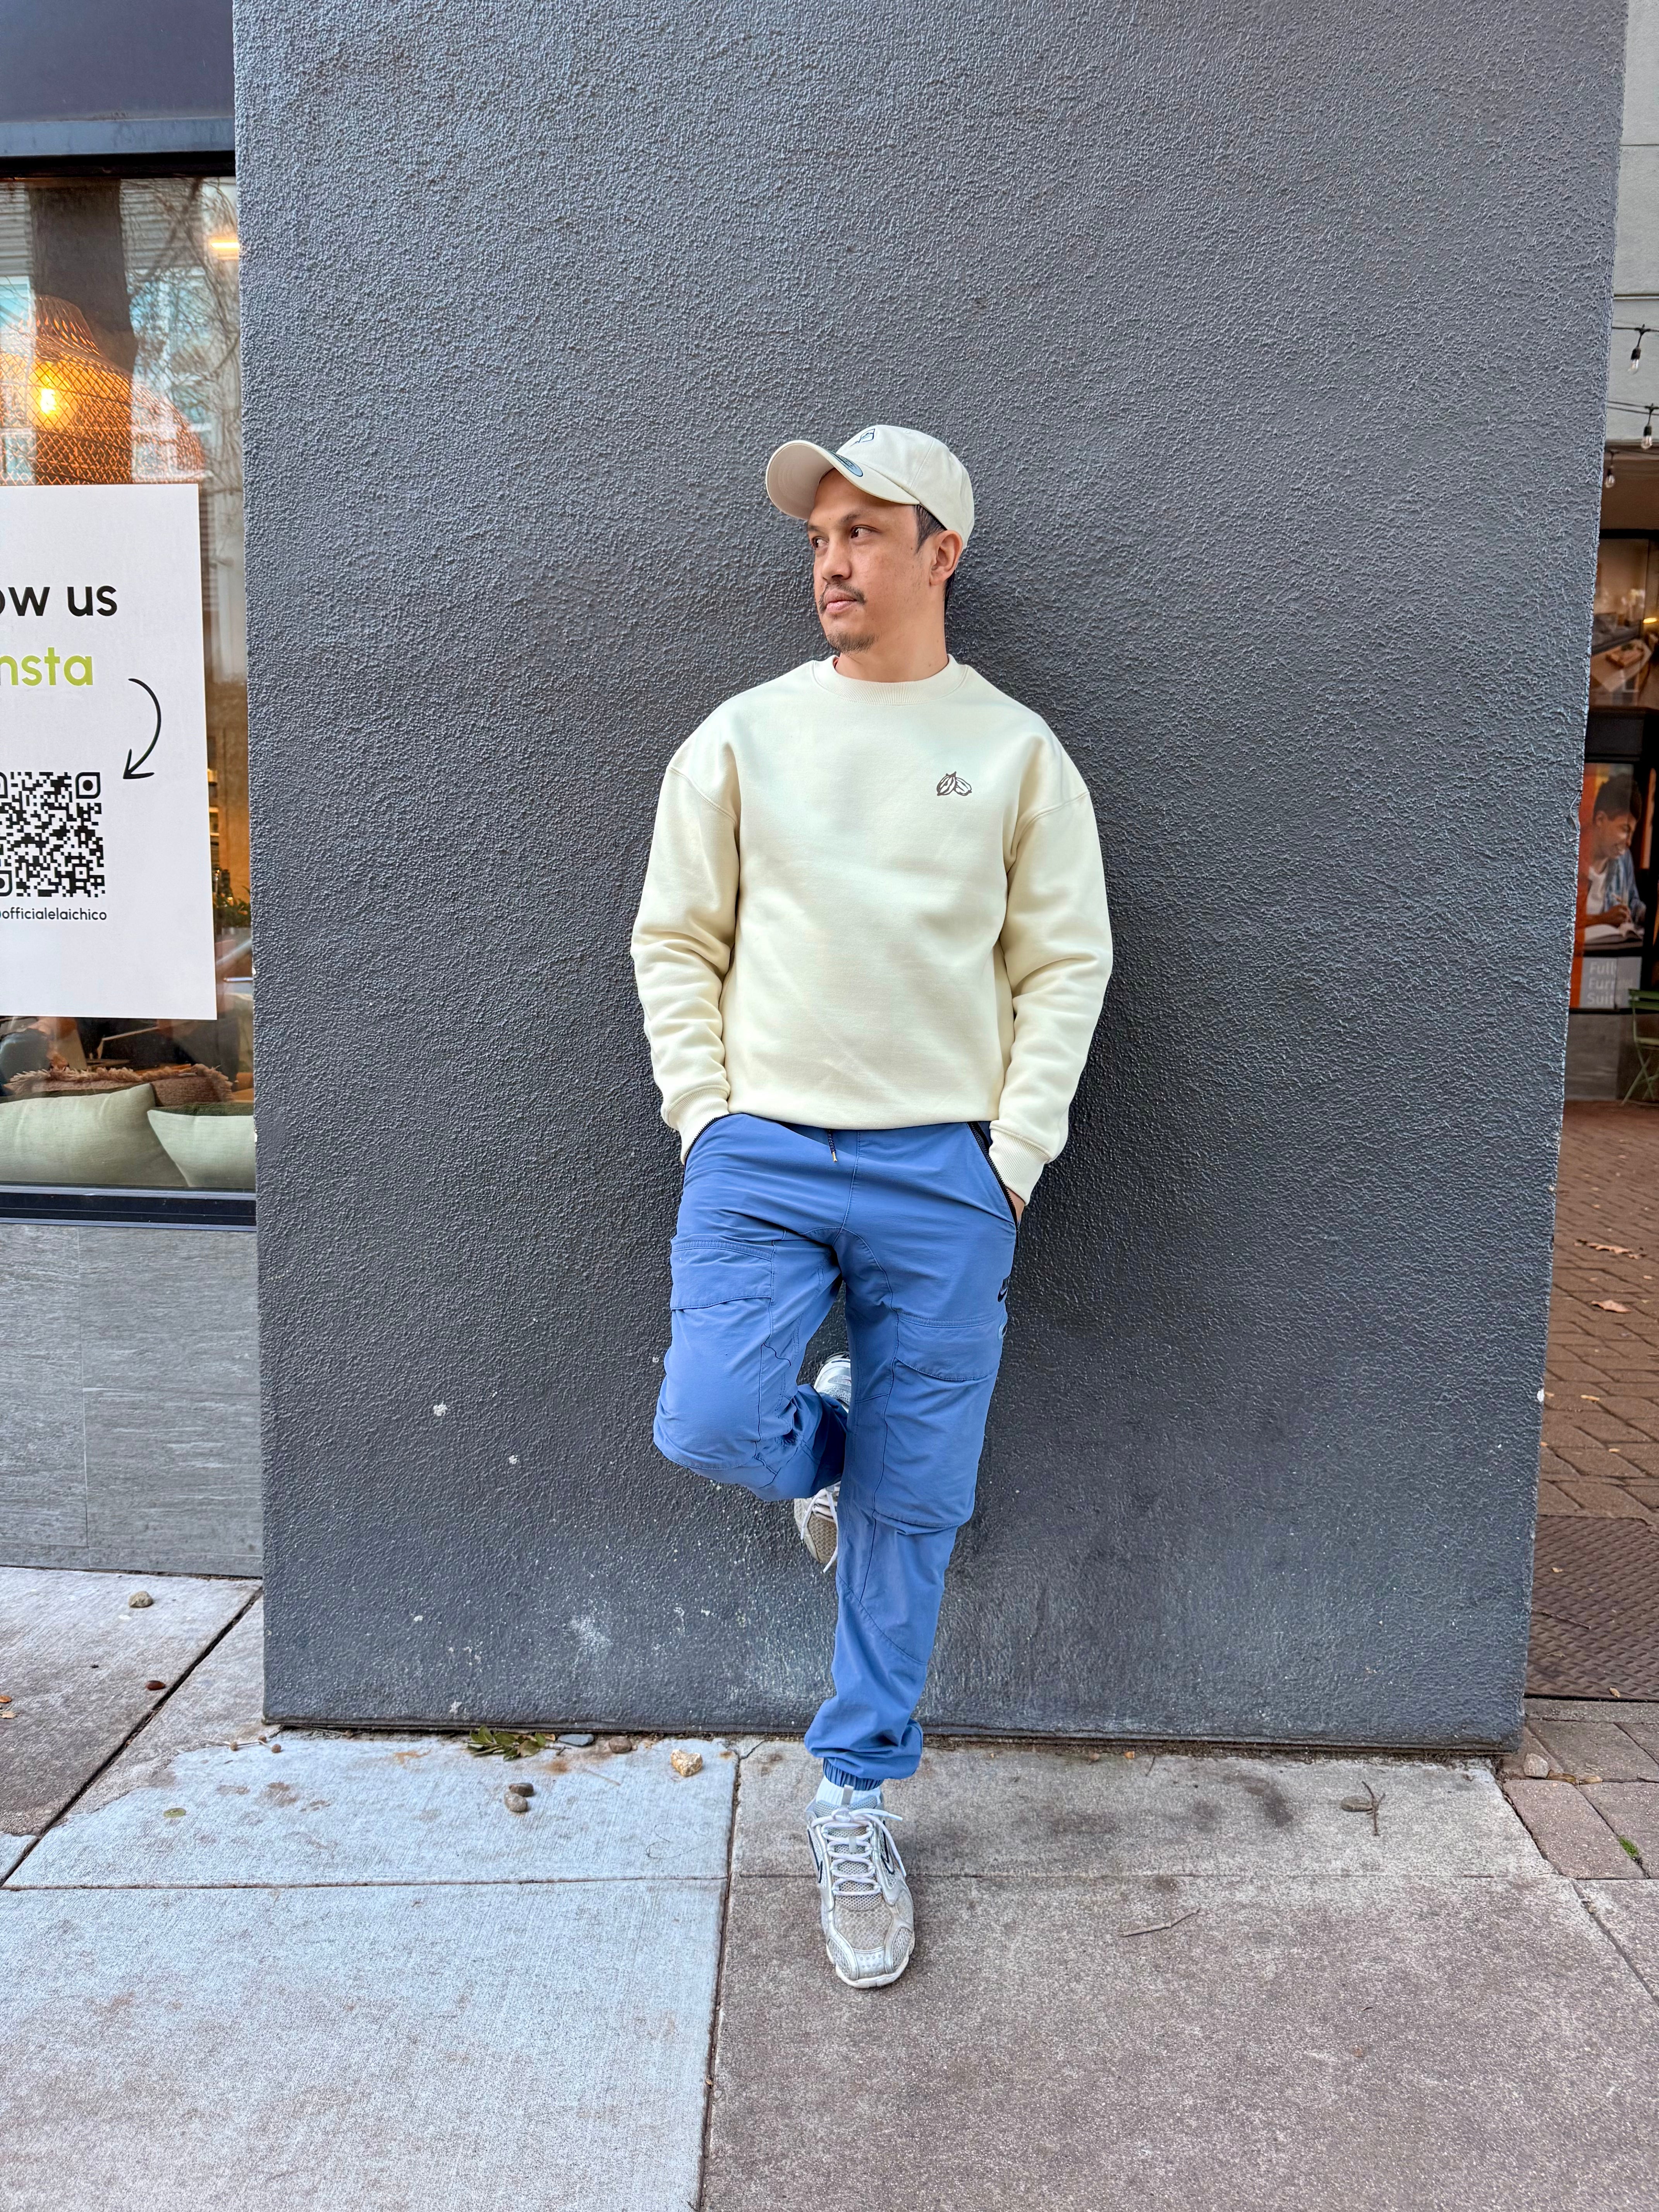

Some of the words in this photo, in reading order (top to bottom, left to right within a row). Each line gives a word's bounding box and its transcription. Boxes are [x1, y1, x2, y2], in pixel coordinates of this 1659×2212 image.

[0, 587, 50, 616] w
[67, 585, 117, 617] us
[0, 907, 107, 920] officialelaichico
